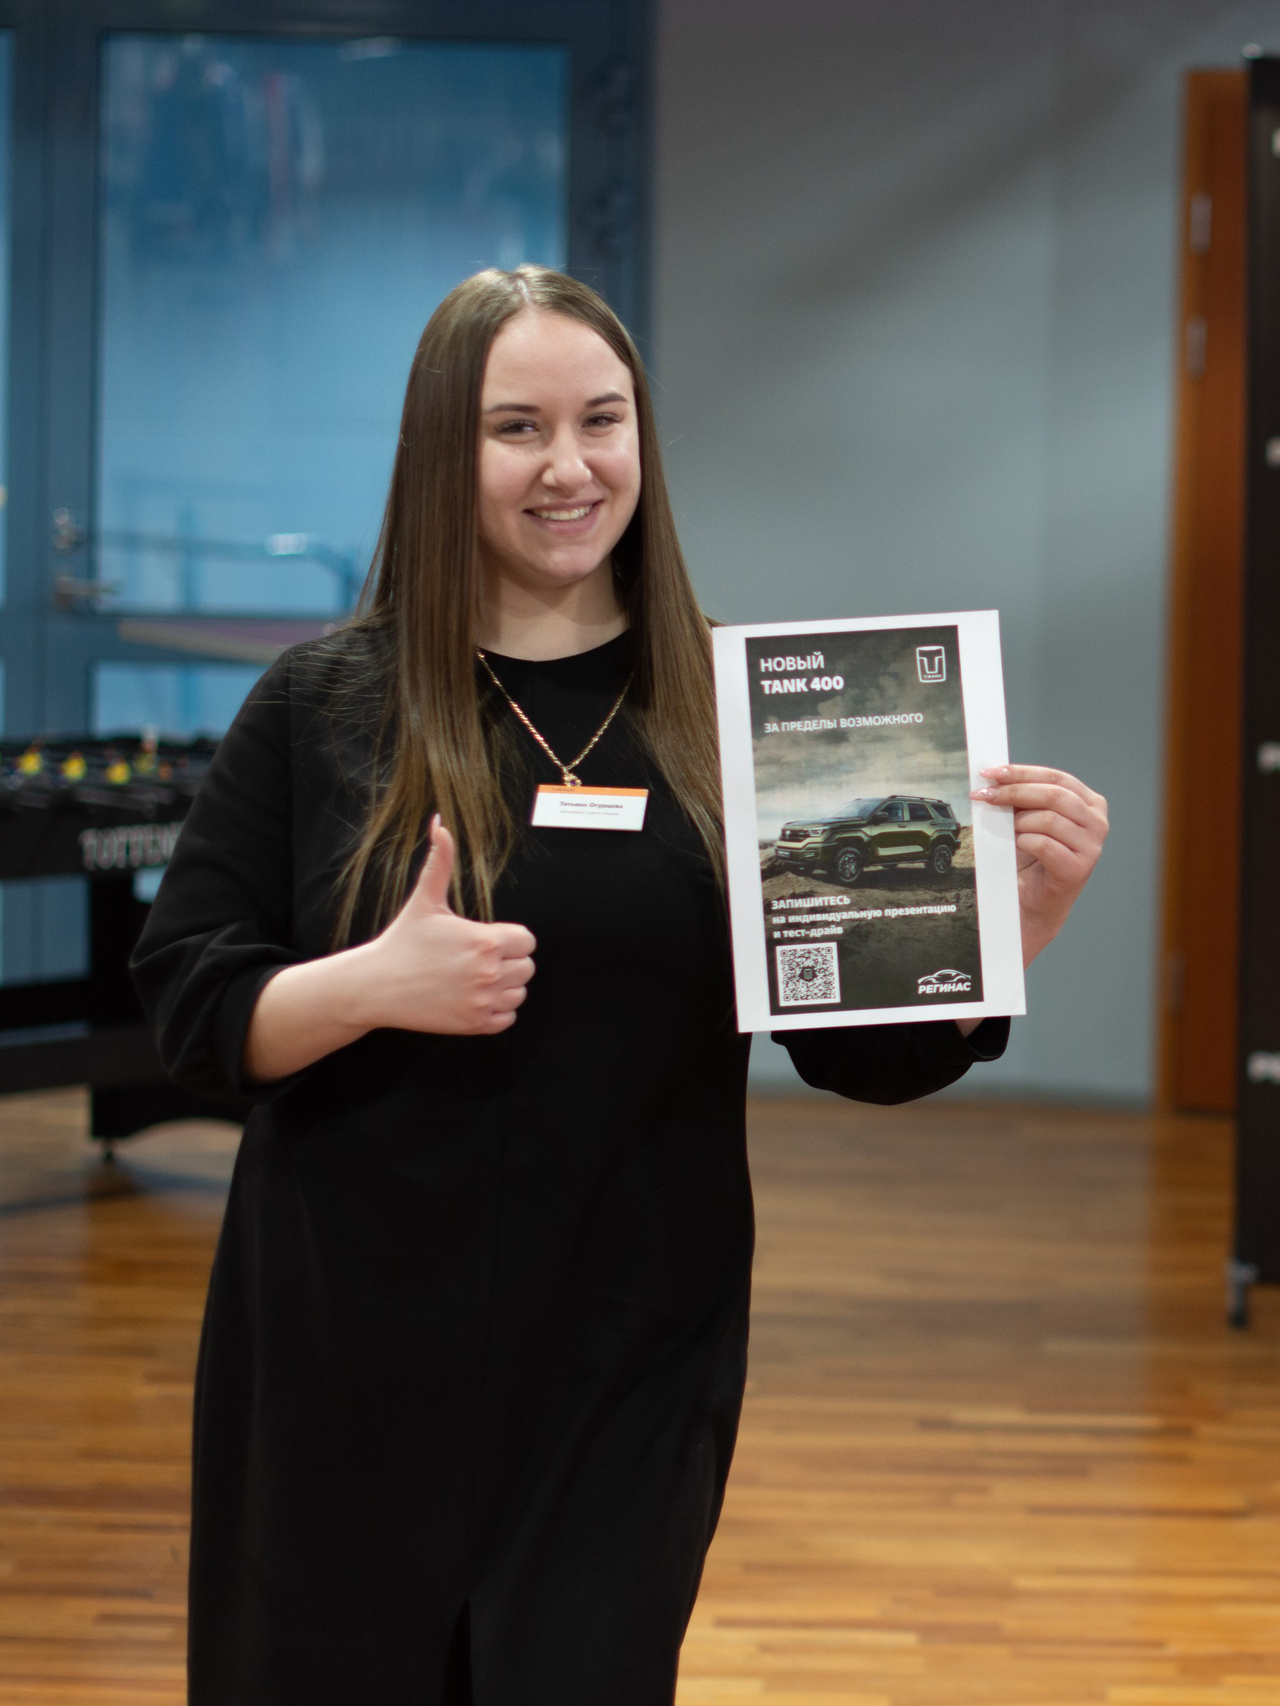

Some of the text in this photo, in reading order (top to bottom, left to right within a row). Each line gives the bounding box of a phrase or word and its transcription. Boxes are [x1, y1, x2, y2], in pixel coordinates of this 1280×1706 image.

[760, 651, 825, 672] НОВЫЙ
[760, 675, 844, 694] TANK 400
[764, 713, 924, 733] ЗА ПРЕДЕЛЫ ВОЗМОЖНОГО
[770, 895, 851, 910] ЗАПИШИТЕСЬ
[772, 904, 957, 924] на индивидуальную презентацию
[773, 924, 844, 939] и тест-драйв
[918, 982, 972, 994] РЕГИНАС
